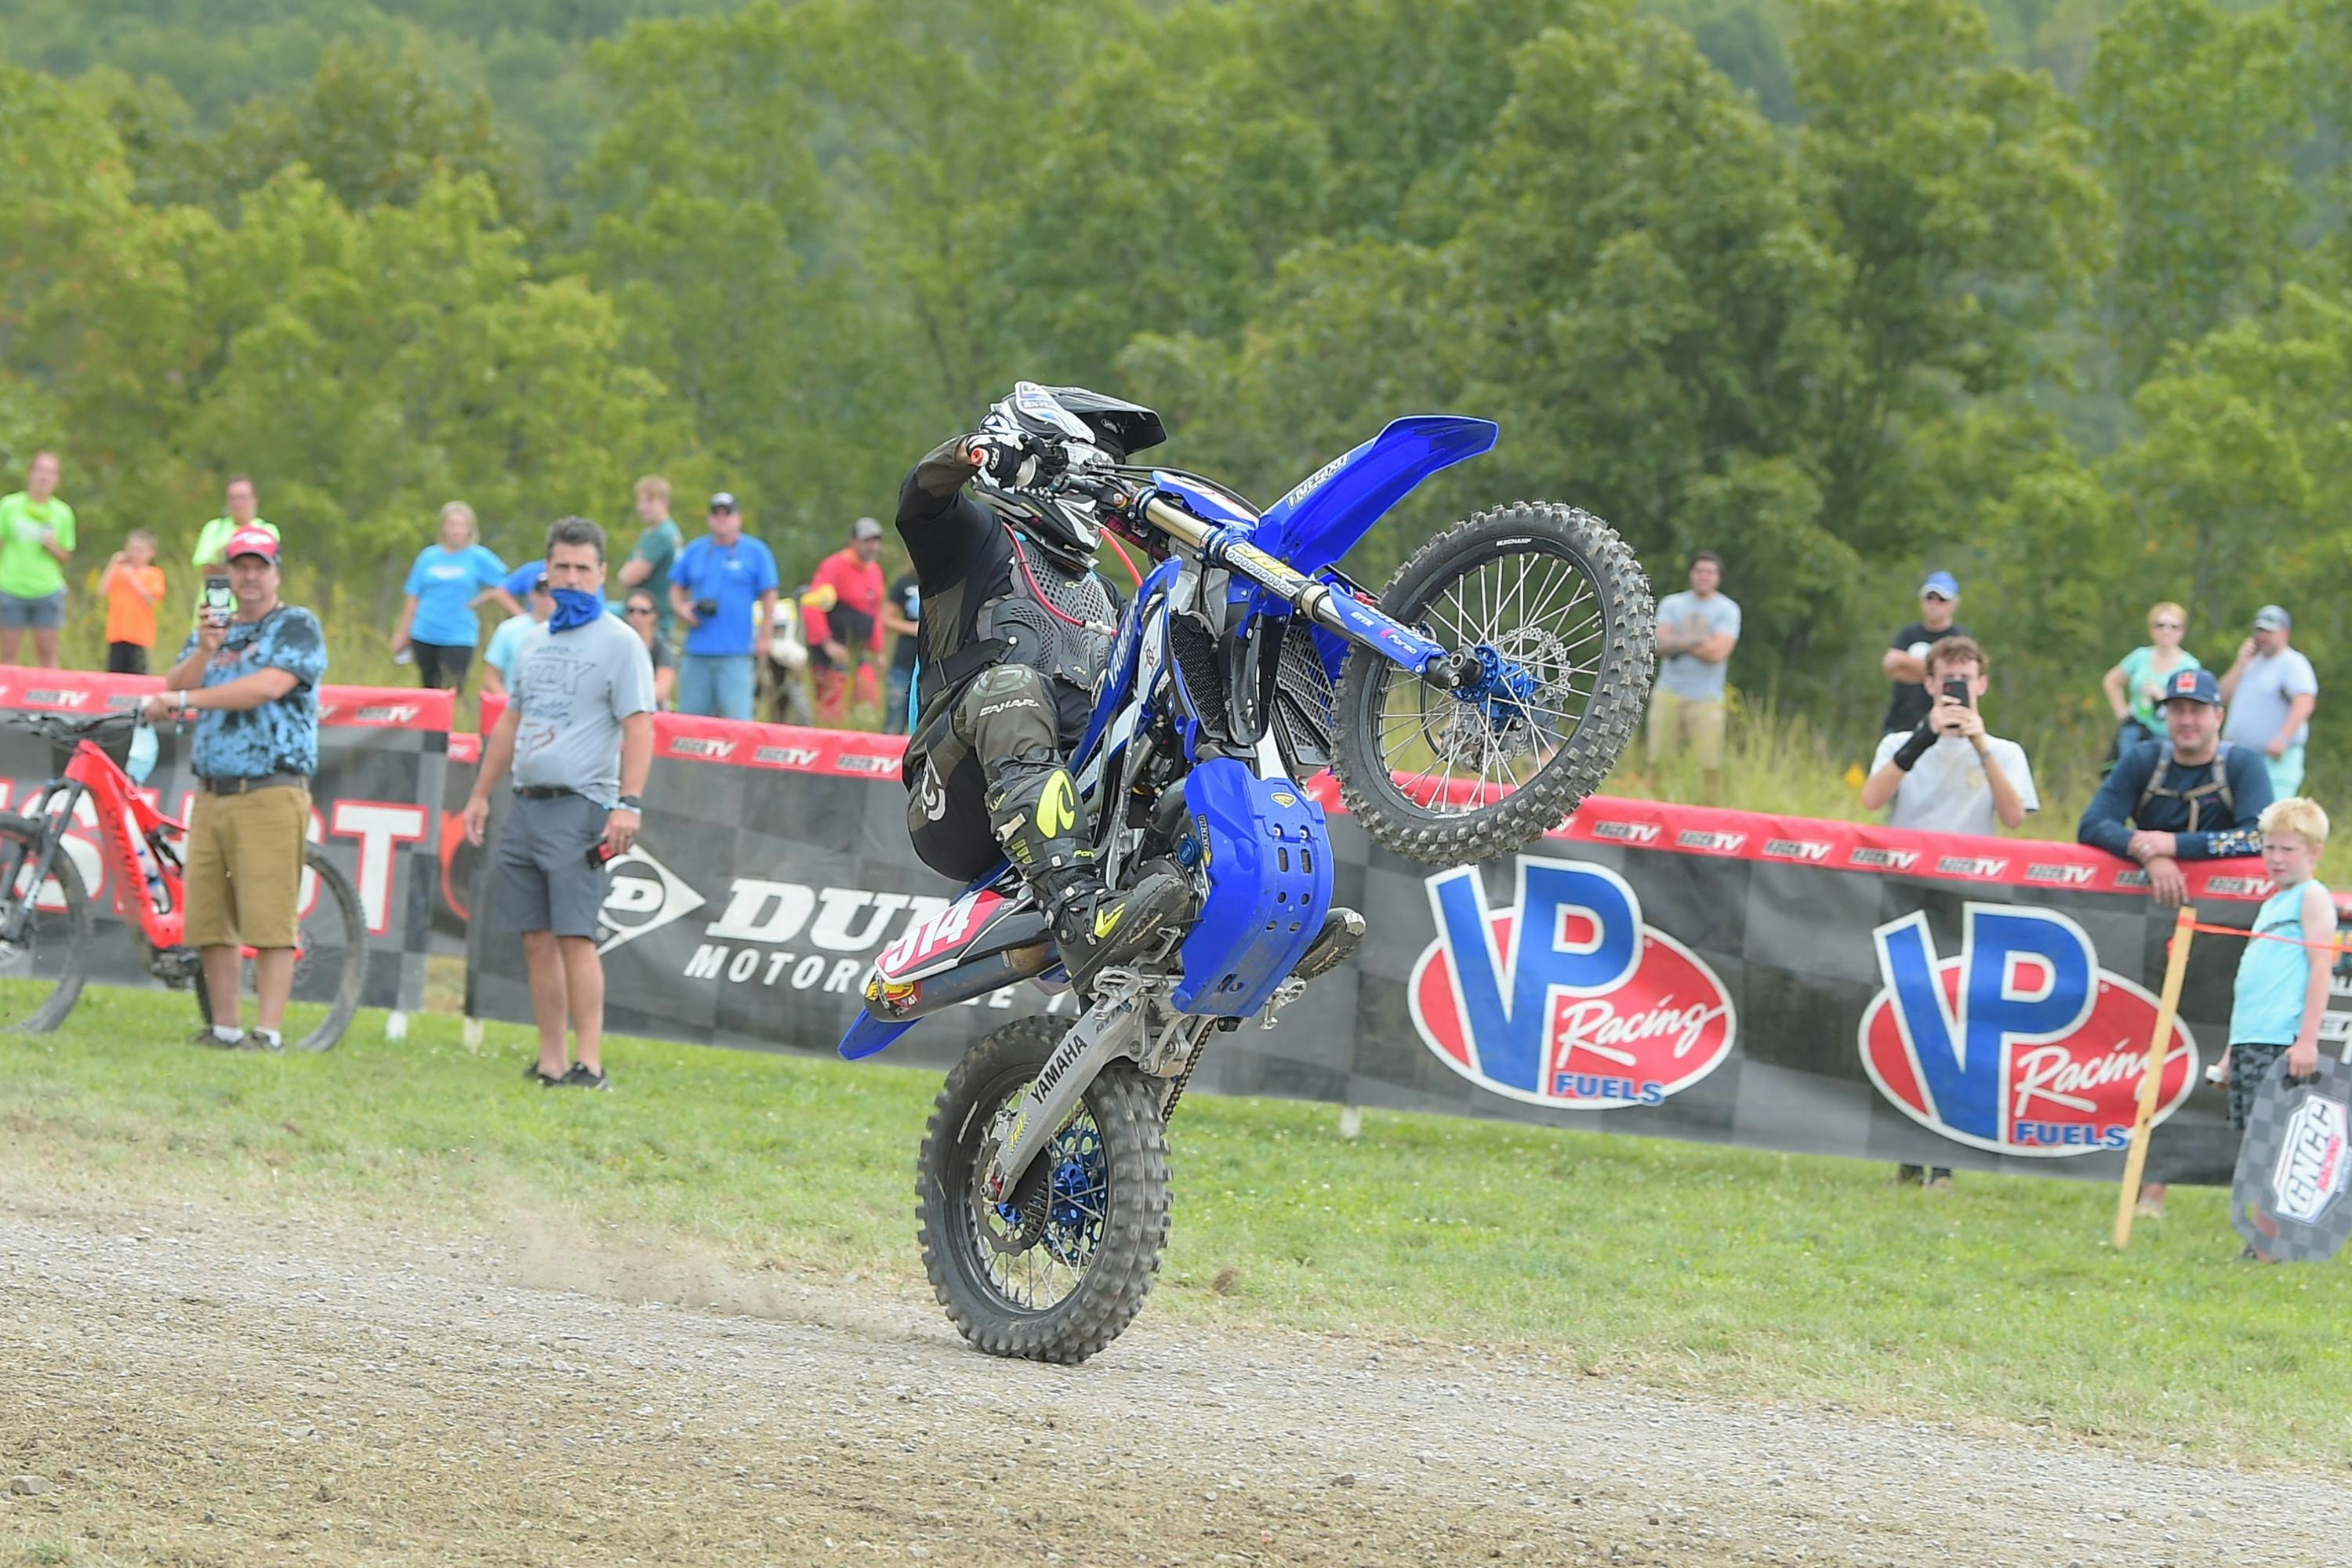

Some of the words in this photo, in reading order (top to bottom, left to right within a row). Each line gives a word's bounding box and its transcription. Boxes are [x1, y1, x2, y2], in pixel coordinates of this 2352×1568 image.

[1427, 855, 1640, 1094] VP
[1557, 994, 1724, 1069] Racing
[1875, 903, 2095, 1142] VP
[1029, 1034, 1088, 1105] YAMAHA
[1555, 1073, 1666, 1105] FUELS
[2015, 1122, 2128, 1150] FUELS
[2285, 1101, 2334, 1214] GNCC
